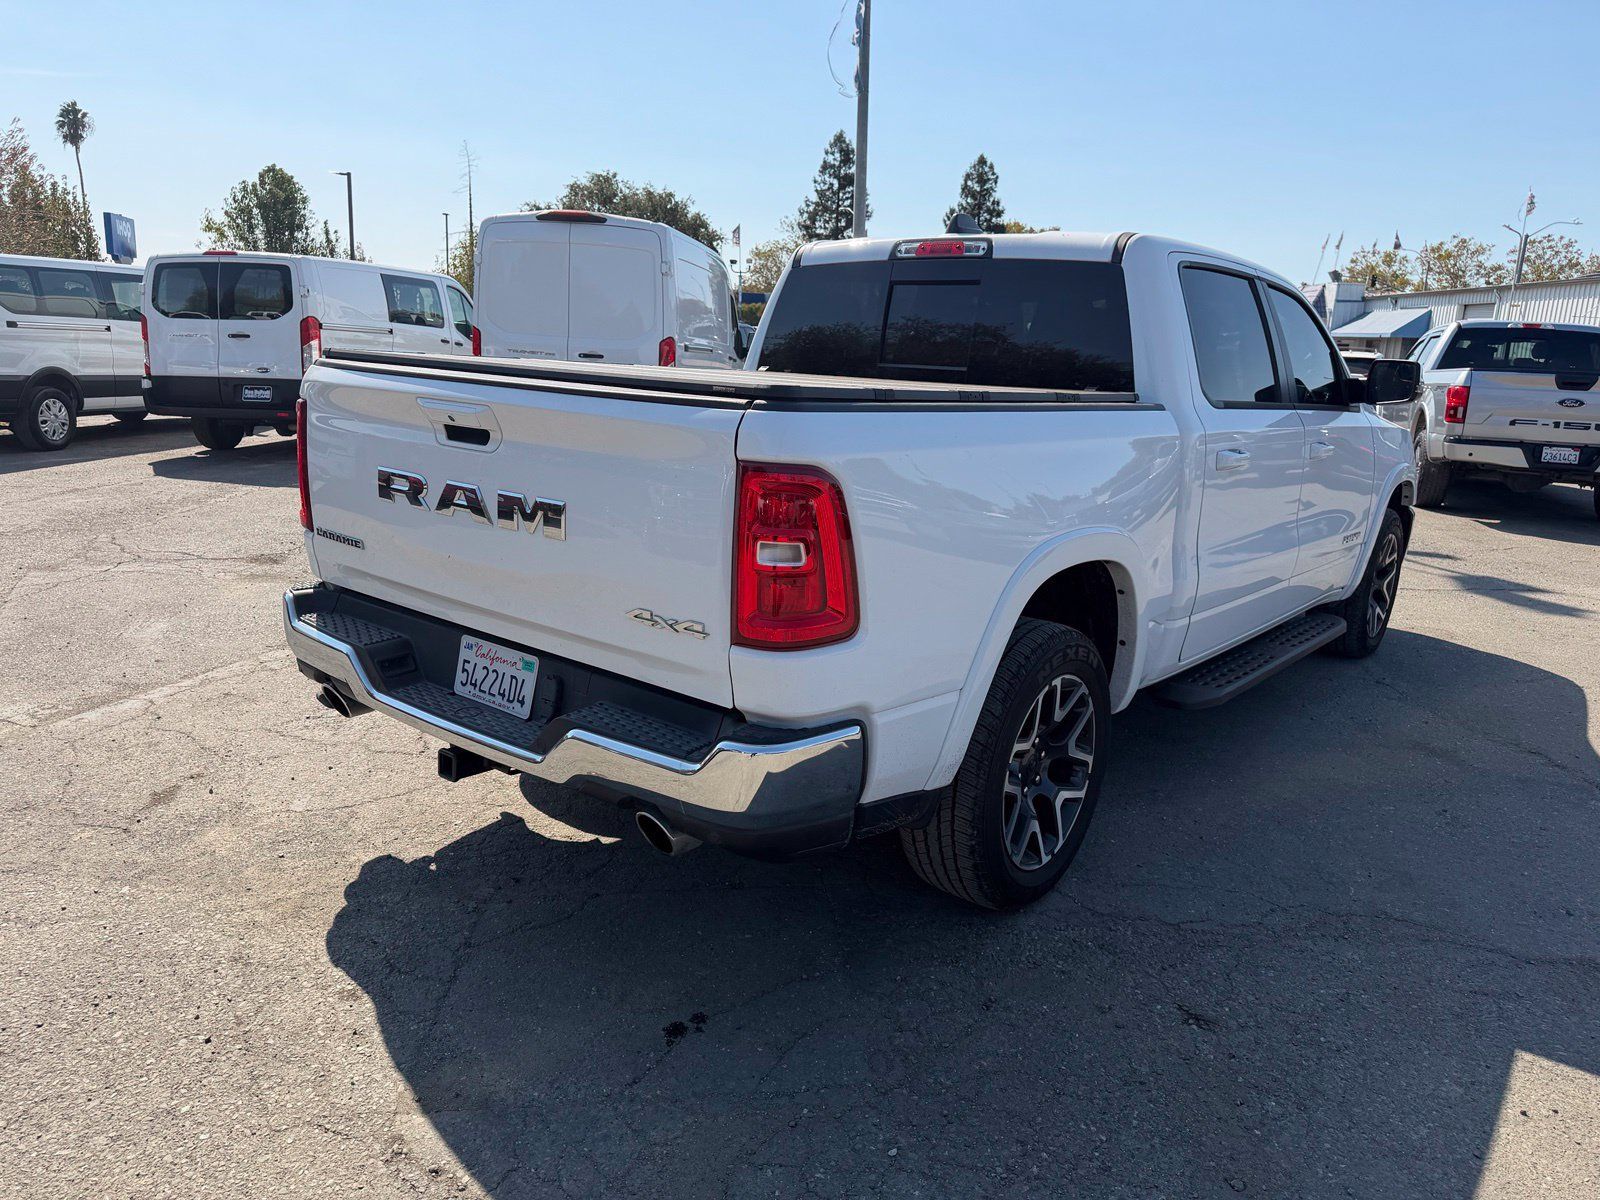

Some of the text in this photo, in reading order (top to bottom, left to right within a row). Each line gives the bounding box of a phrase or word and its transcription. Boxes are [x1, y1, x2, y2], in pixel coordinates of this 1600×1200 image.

[1561, 399, 1582, 408] Ford
[1509, 418, 1600, 431] F-15
[377, 465, 566, 541] RAM
[316, 526, 362, 549] LARAMIE
[474, 643, 521, 671] California
[1037, 645, 1099, 680] NEXEN
[460, 658, 526, 708] 54224D4
